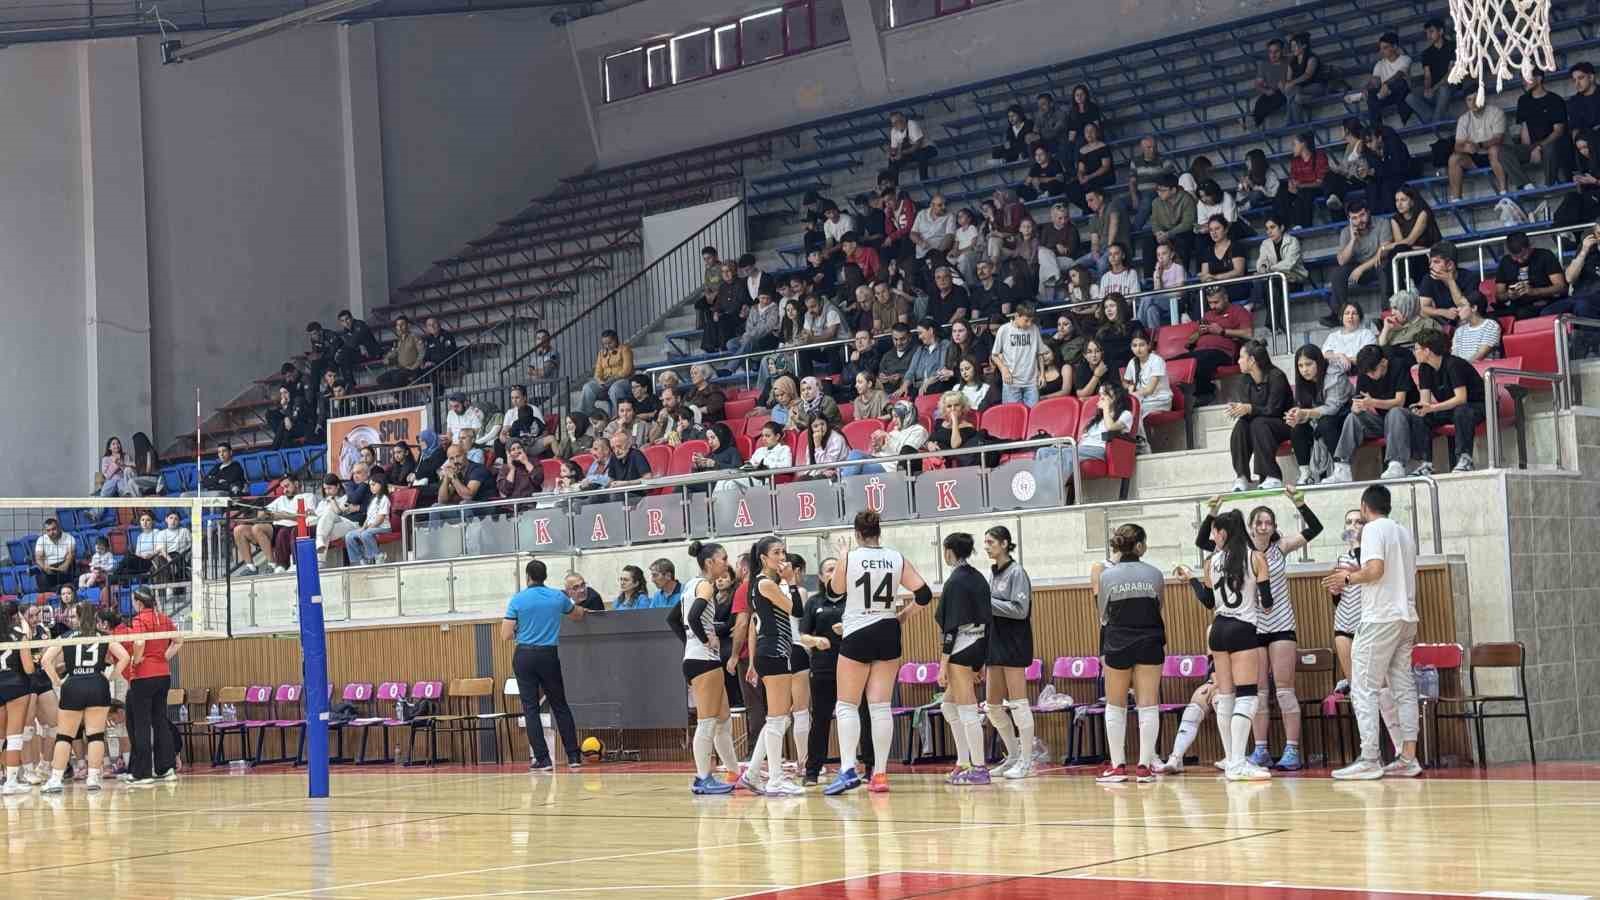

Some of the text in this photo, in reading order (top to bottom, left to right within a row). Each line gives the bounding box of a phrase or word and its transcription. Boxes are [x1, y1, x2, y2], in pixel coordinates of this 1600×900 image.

[379, 418, 409, 441] SPOR
[861, 557, 893, 570] ÇETİN
[855, 571, 894, 609] 14
[75, 642, 99, 667] 13
